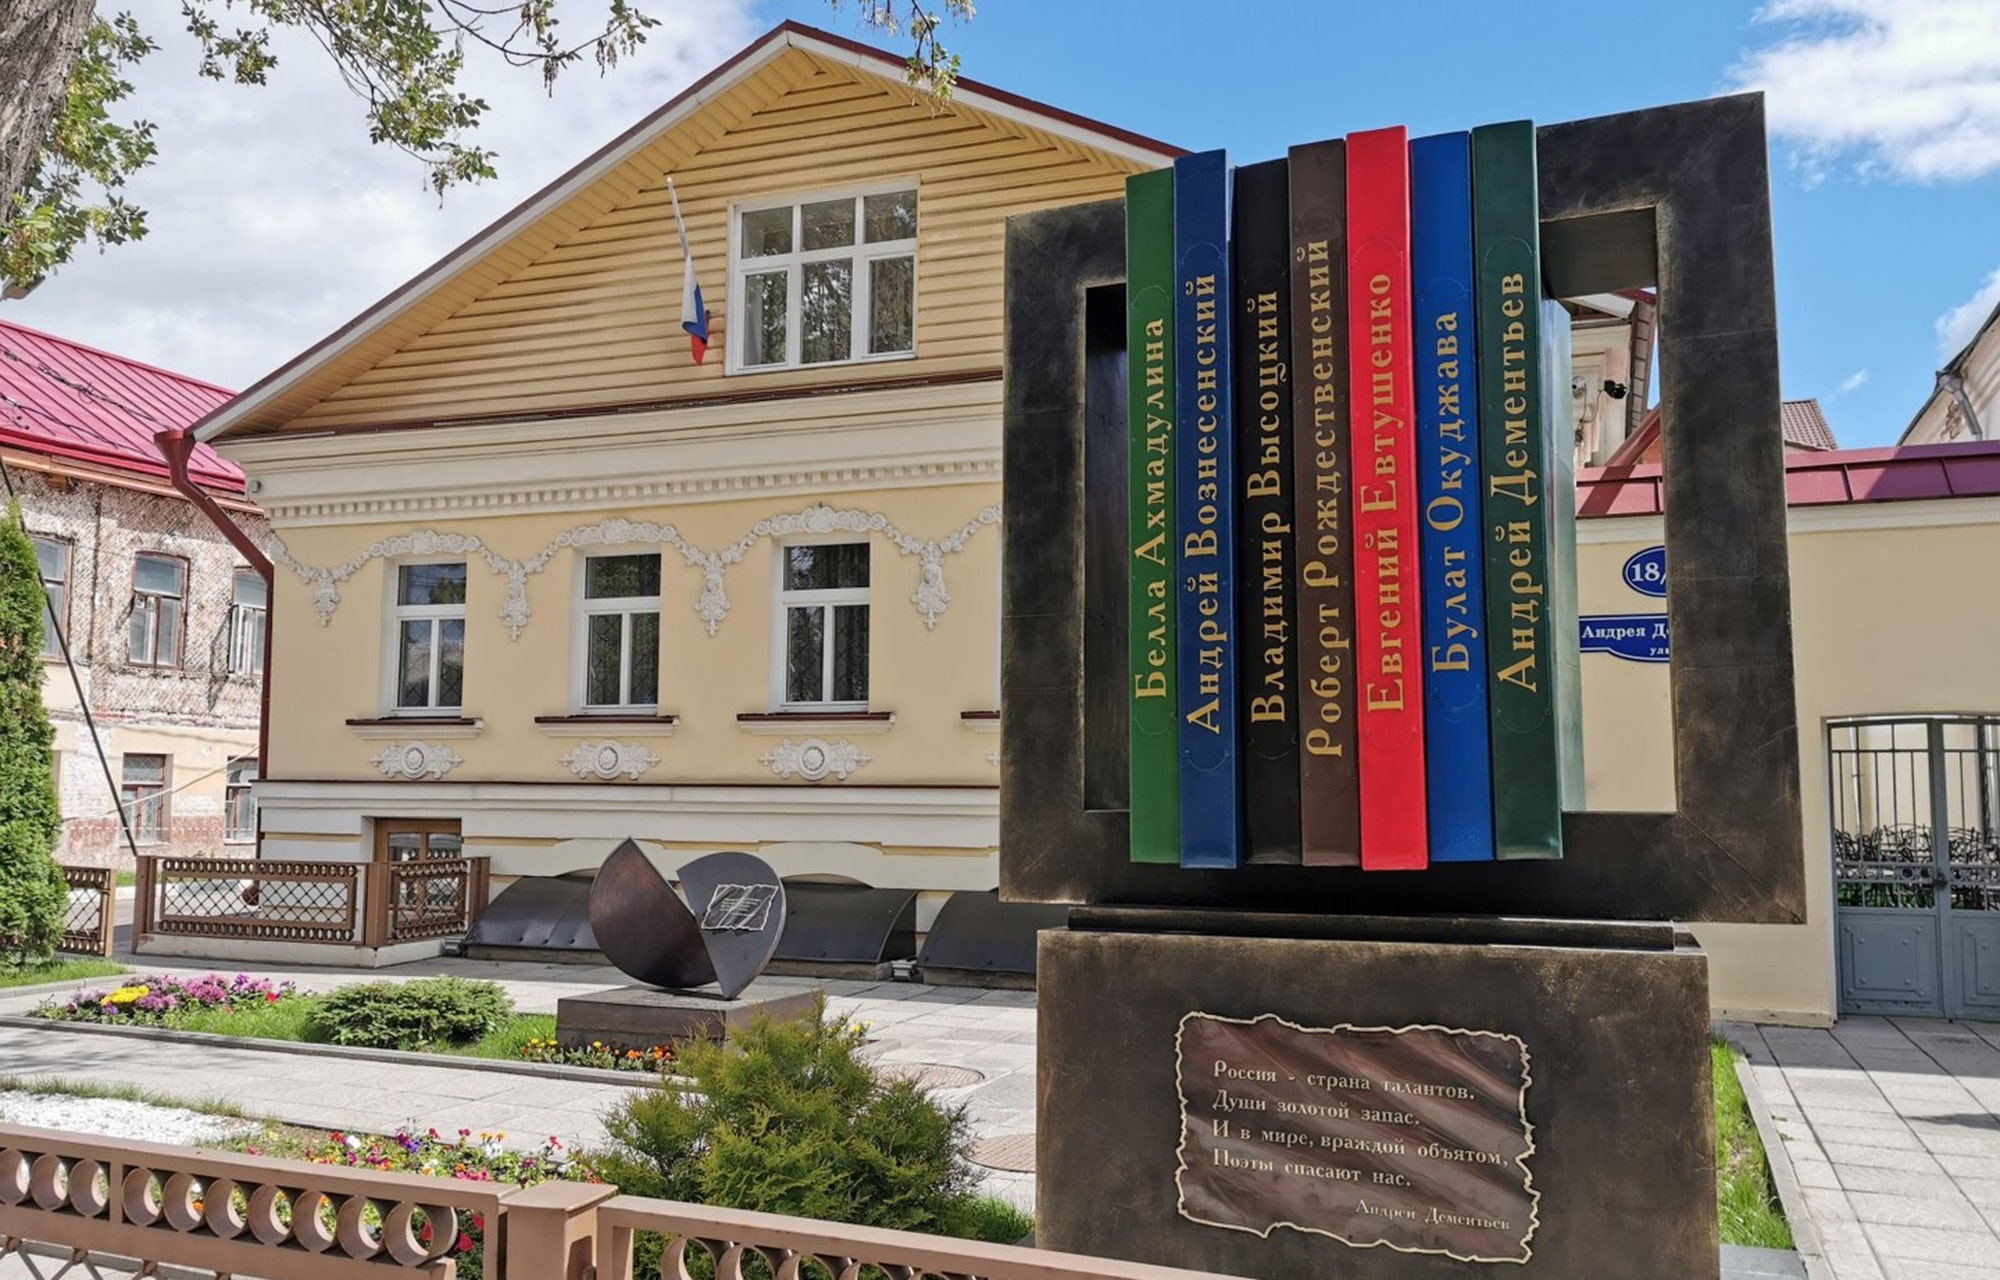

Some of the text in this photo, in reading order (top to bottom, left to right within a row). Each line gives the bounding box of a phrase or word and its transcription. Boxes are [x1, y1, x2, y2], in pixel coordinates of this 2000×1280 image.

[1134, 318, 1172, 699] Белла Ахмадулина
[1184, 273, 1228, 734] Андрей Вознесенский
[1247, 291, 1291, 723] Владимир Высоцкий
[1296, 239, 1350, 758] Роберт Рождественский
[1360, 273, 1405, 712] Евгений Евтушенко
[1426, 311, 1478, 672] Булат Окуджава
[1491, 273, 1544, 693] Андрей Дементьев
[1581, 625, 1646, 640] Андрея
[1212, 1090, 1420, 1126] Души золотой запас.
[1213, 1119, 1509, 1168] И в мире, враждой объятом,
[1213, 1148, 1412, 1187] Поэты спасают нас.
[1214, 1060, 1277, 1083] Россия
[1307, 1075, 1371, 1091] страна
[1382, 1080, 1475, 1100] талантов.
[1355, 1199, 1510, 1230] Андрей Дементьев
